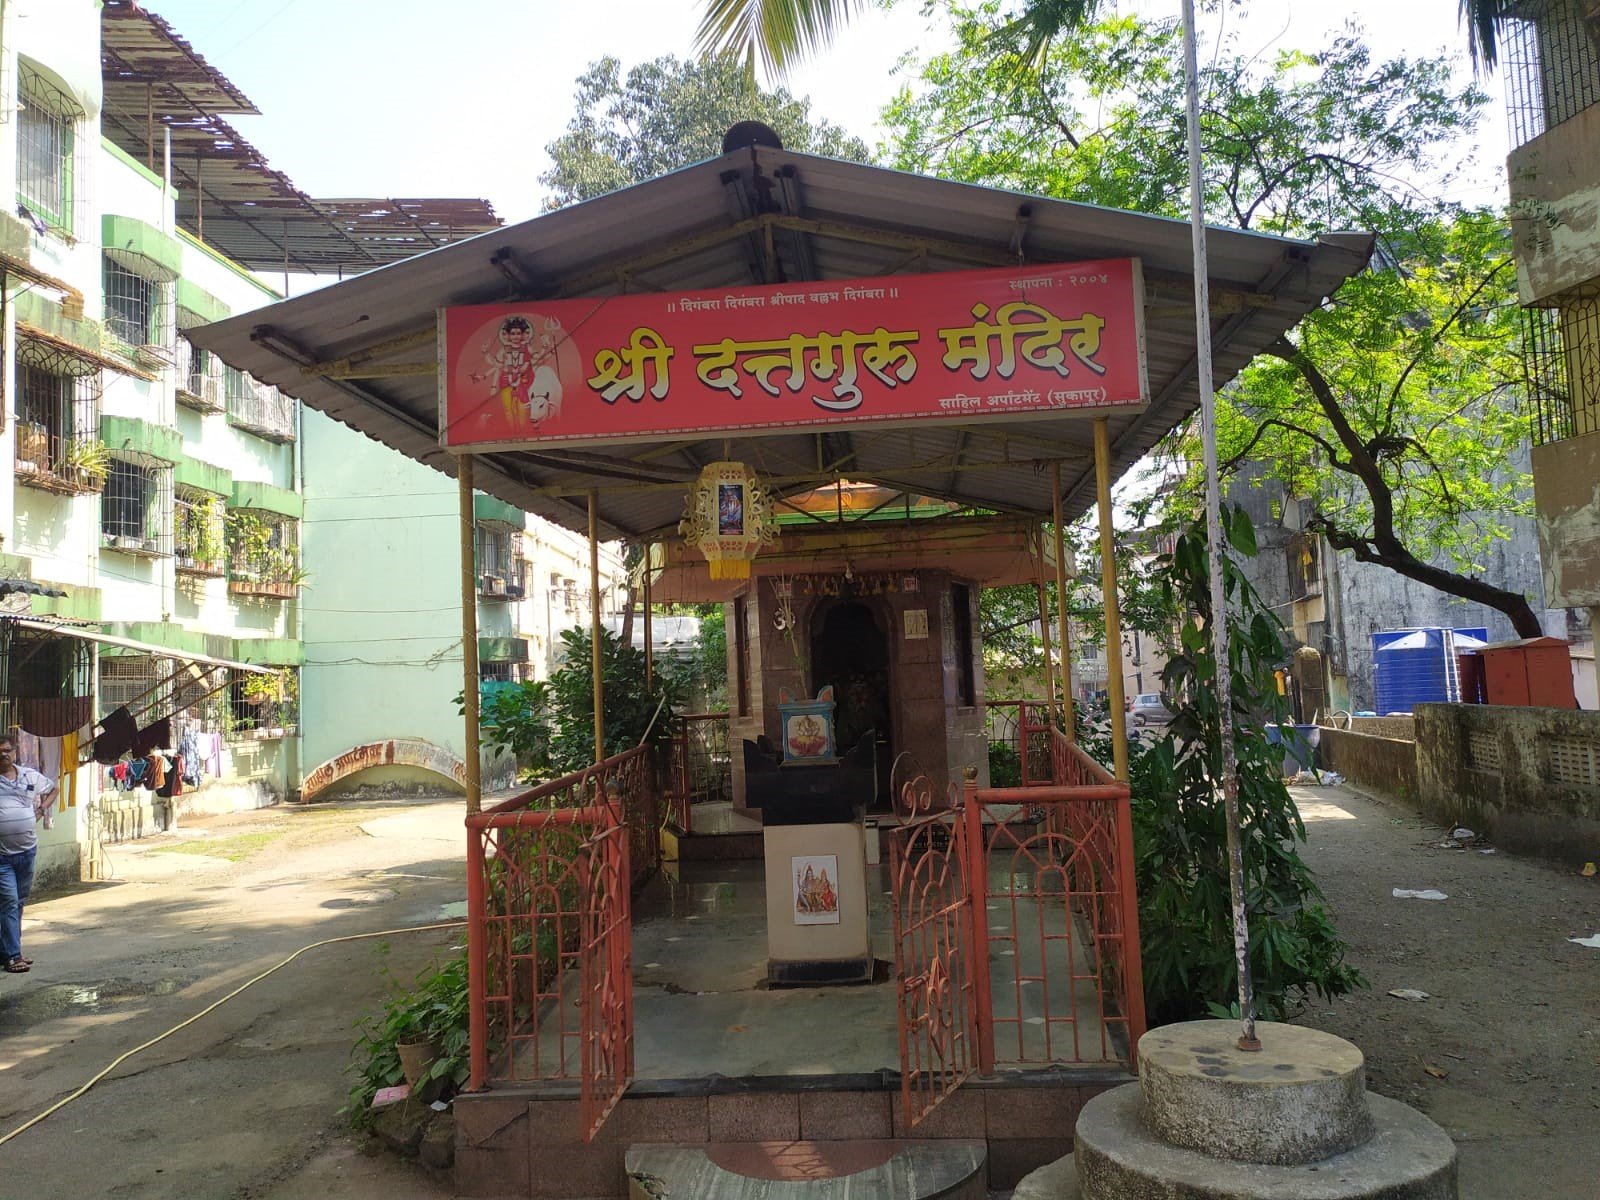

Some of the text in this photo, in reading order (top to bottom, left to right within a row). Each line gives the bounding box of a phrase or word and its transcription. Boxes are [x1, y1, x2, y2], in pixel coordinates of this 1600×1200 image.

[1008, 277, 1053, 290] स्थापना
[1070, 274, 1109, 286] २००४
[680, 297, 721, 312] दिगंबरा
[725, 294, 765, 309] दिगंबरा
[769, 291, 805, 306] श्रीपाद
[809, 291, 840, 305] वल्लभ
[843, 285, 885, 301] दिगंबरा
[587, 326, 674, 403] श्री
[938, 300, 1106, 380] मंदिर
[939, 393, 981, 410] साहिल
[1047, 386, 1108, 406] (सुकापूर)
